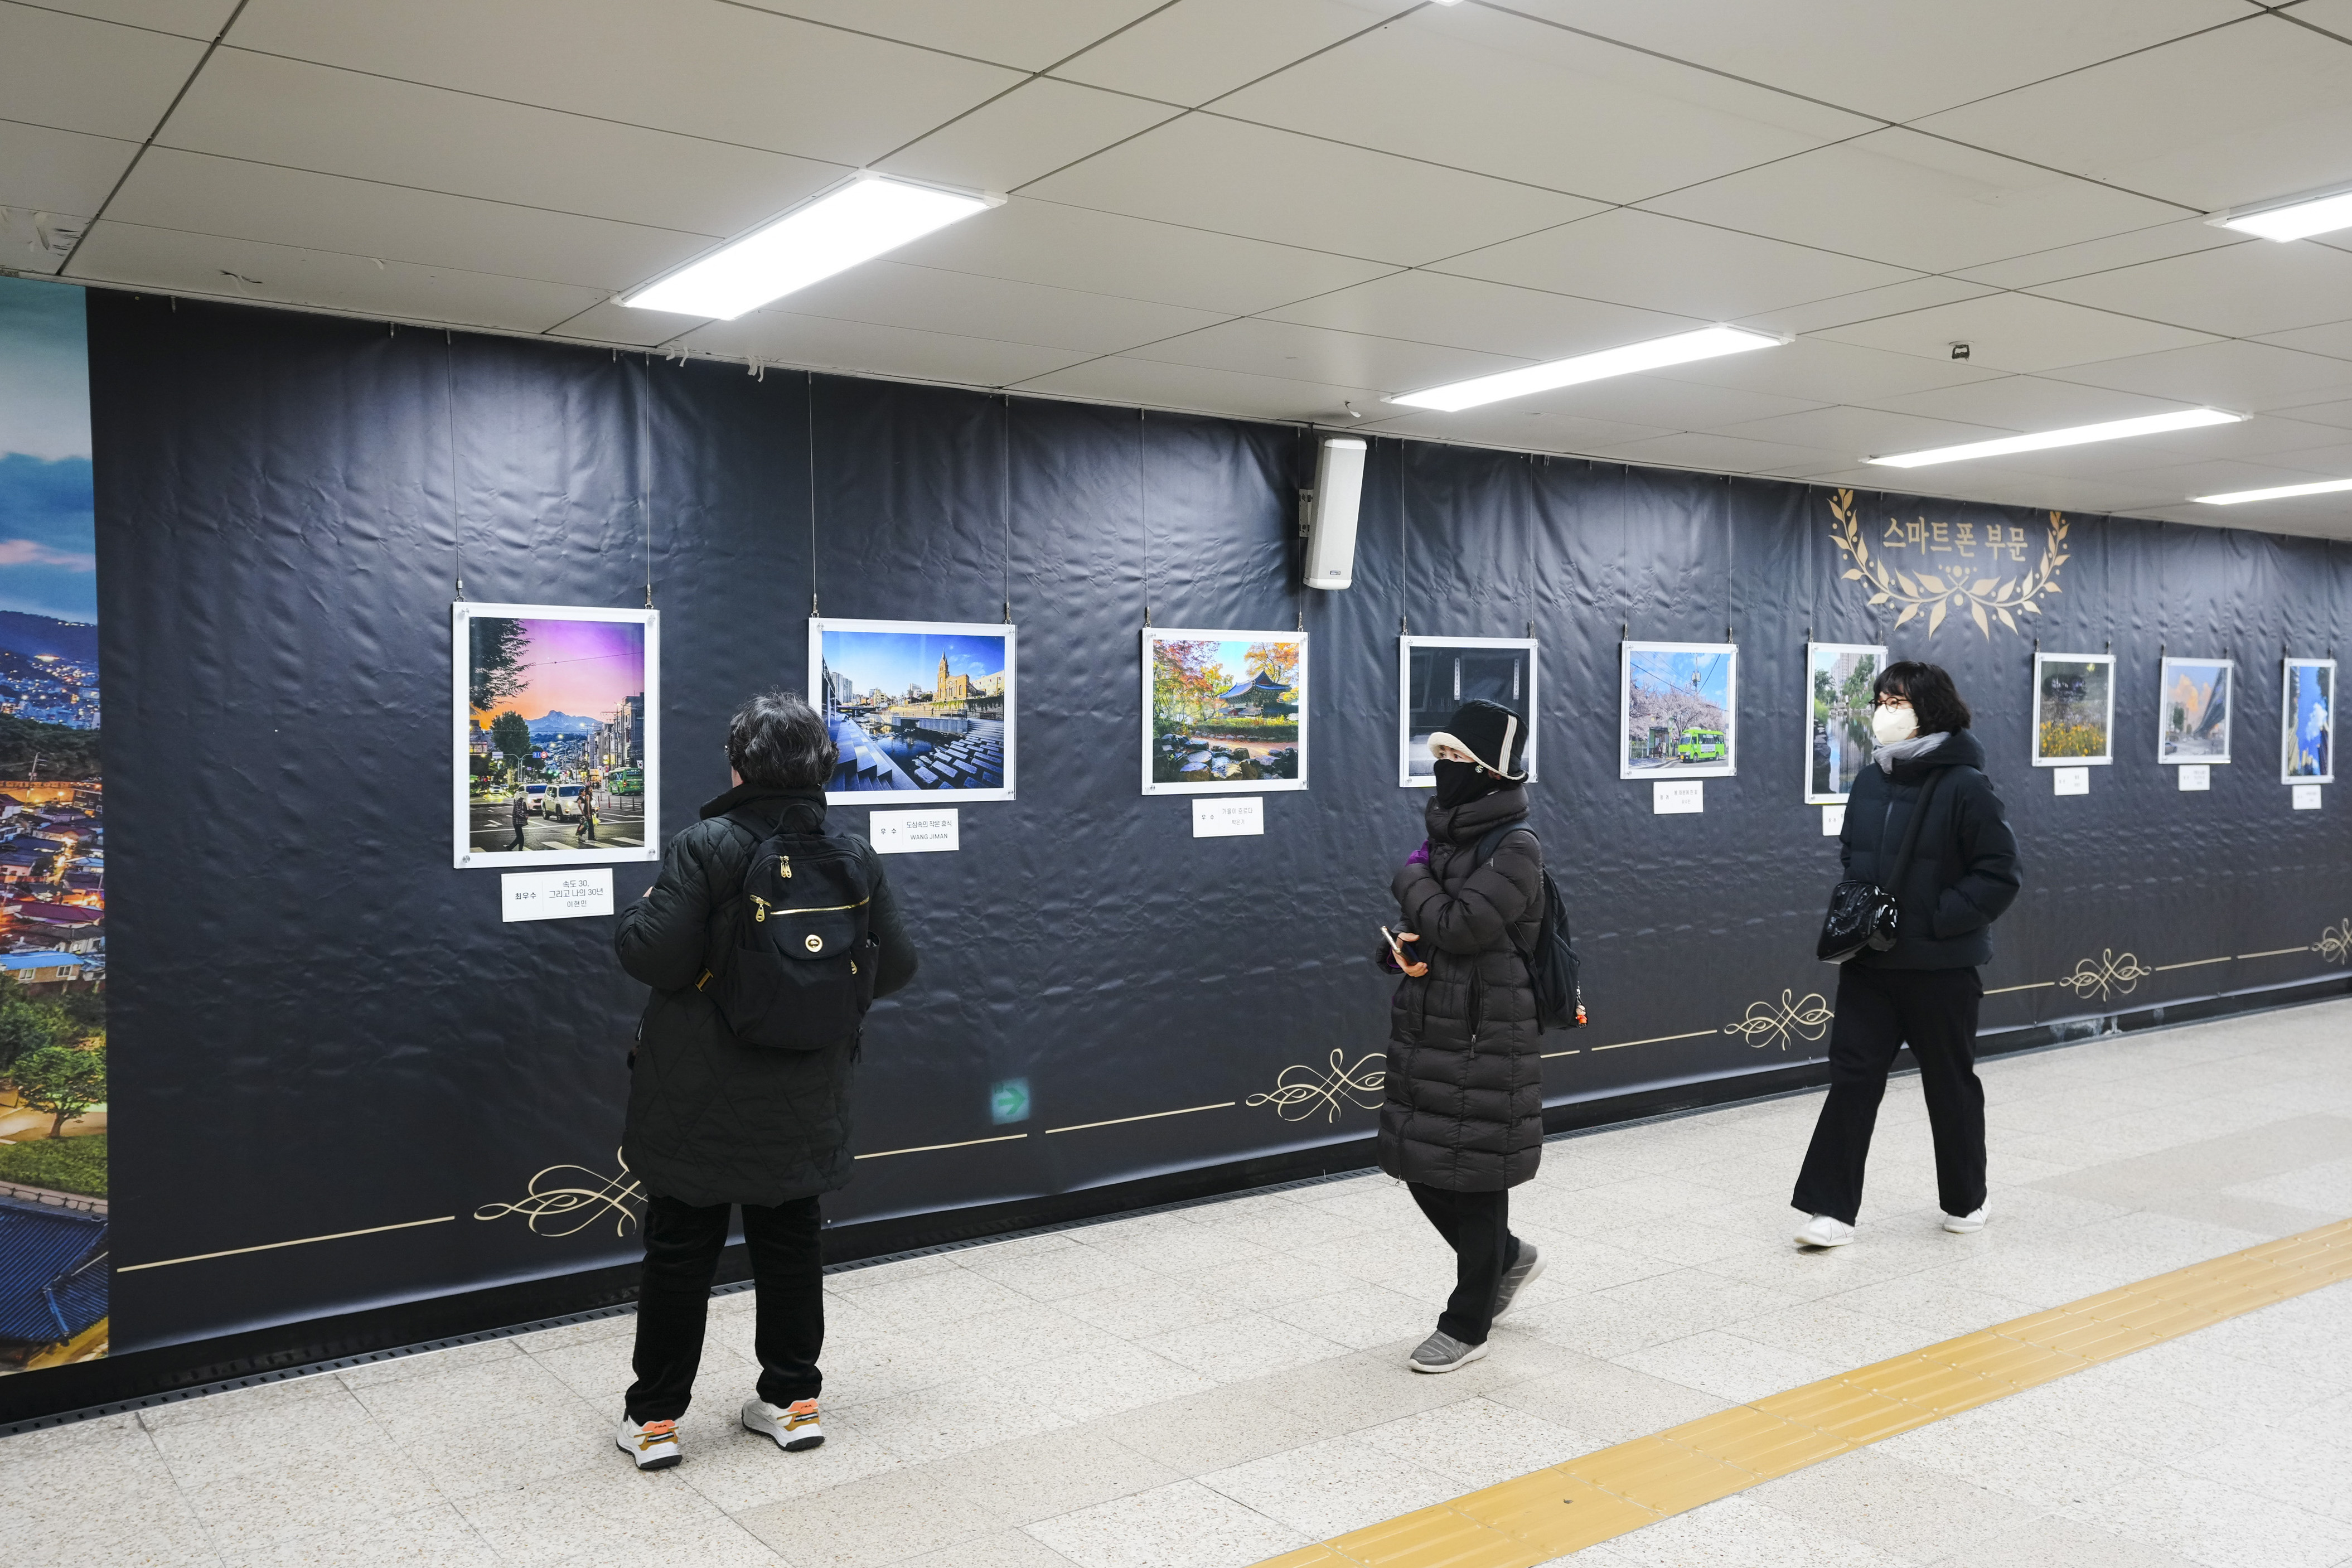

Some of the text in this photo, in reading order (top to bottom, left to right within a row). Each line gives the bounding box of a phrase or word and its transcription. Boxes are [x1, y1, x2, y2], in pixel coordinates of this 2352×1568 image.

[1882, 516, 2029, 562] 스마트폰 부문
[578, 879, 589, 888] 30,
[515, 892, 537, 900] 최우수
[549, 888, 603, 898] 그리고 나의 30년
